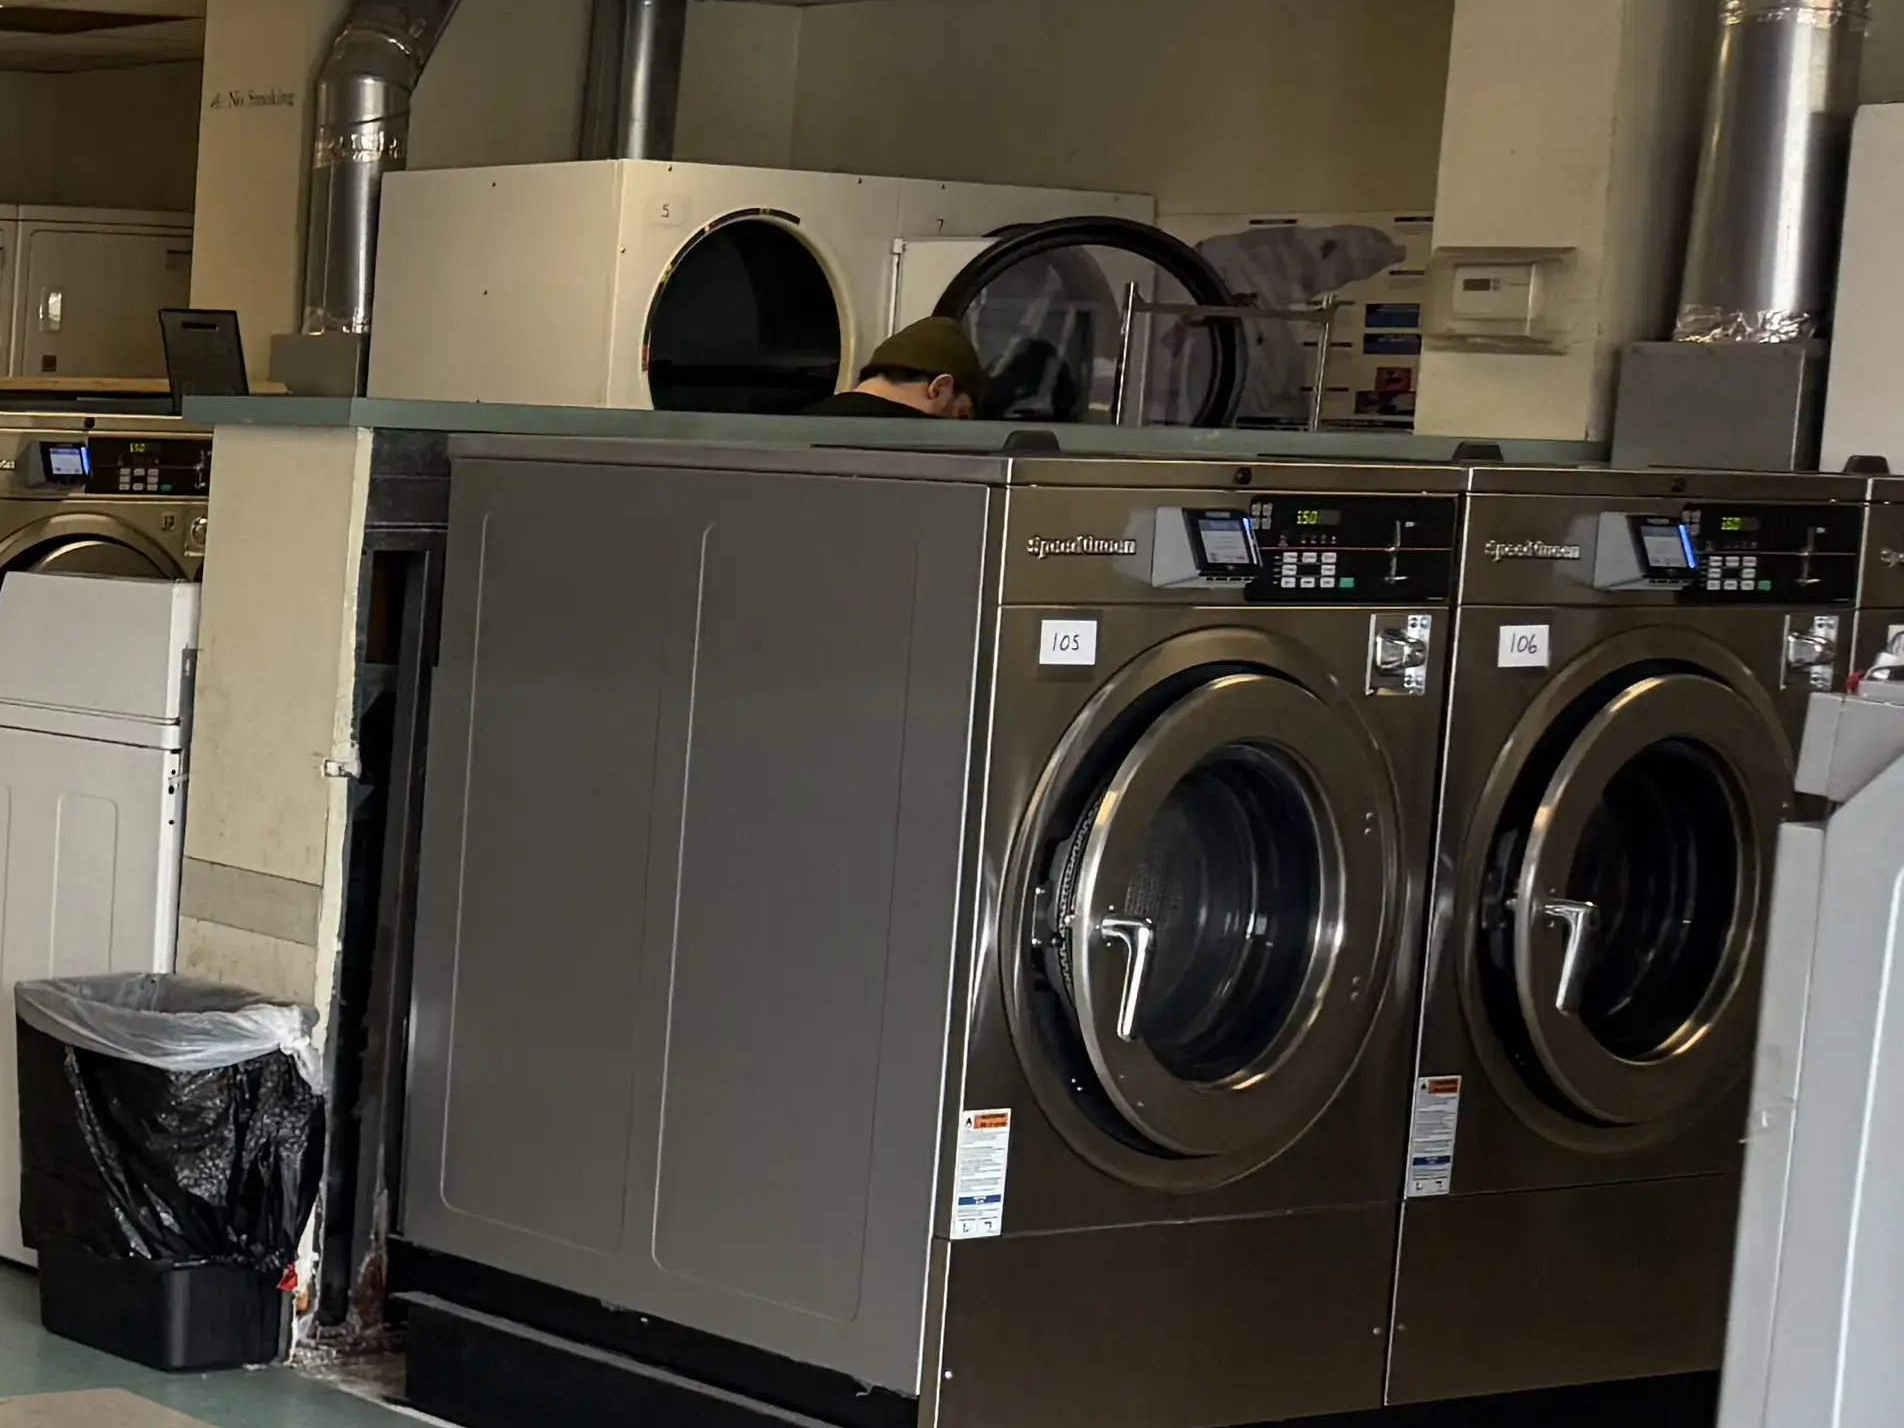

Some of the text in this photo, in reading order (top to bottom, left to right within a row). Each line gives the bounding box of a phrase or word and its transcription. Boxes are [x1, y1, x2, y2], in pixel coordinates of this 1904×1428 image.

[660, 203, 671, 219] 5
[937, 218, 945, 233] 7
[1052, 632, 1080, 652] 105
[1510, 632, 1538, 655] 106
